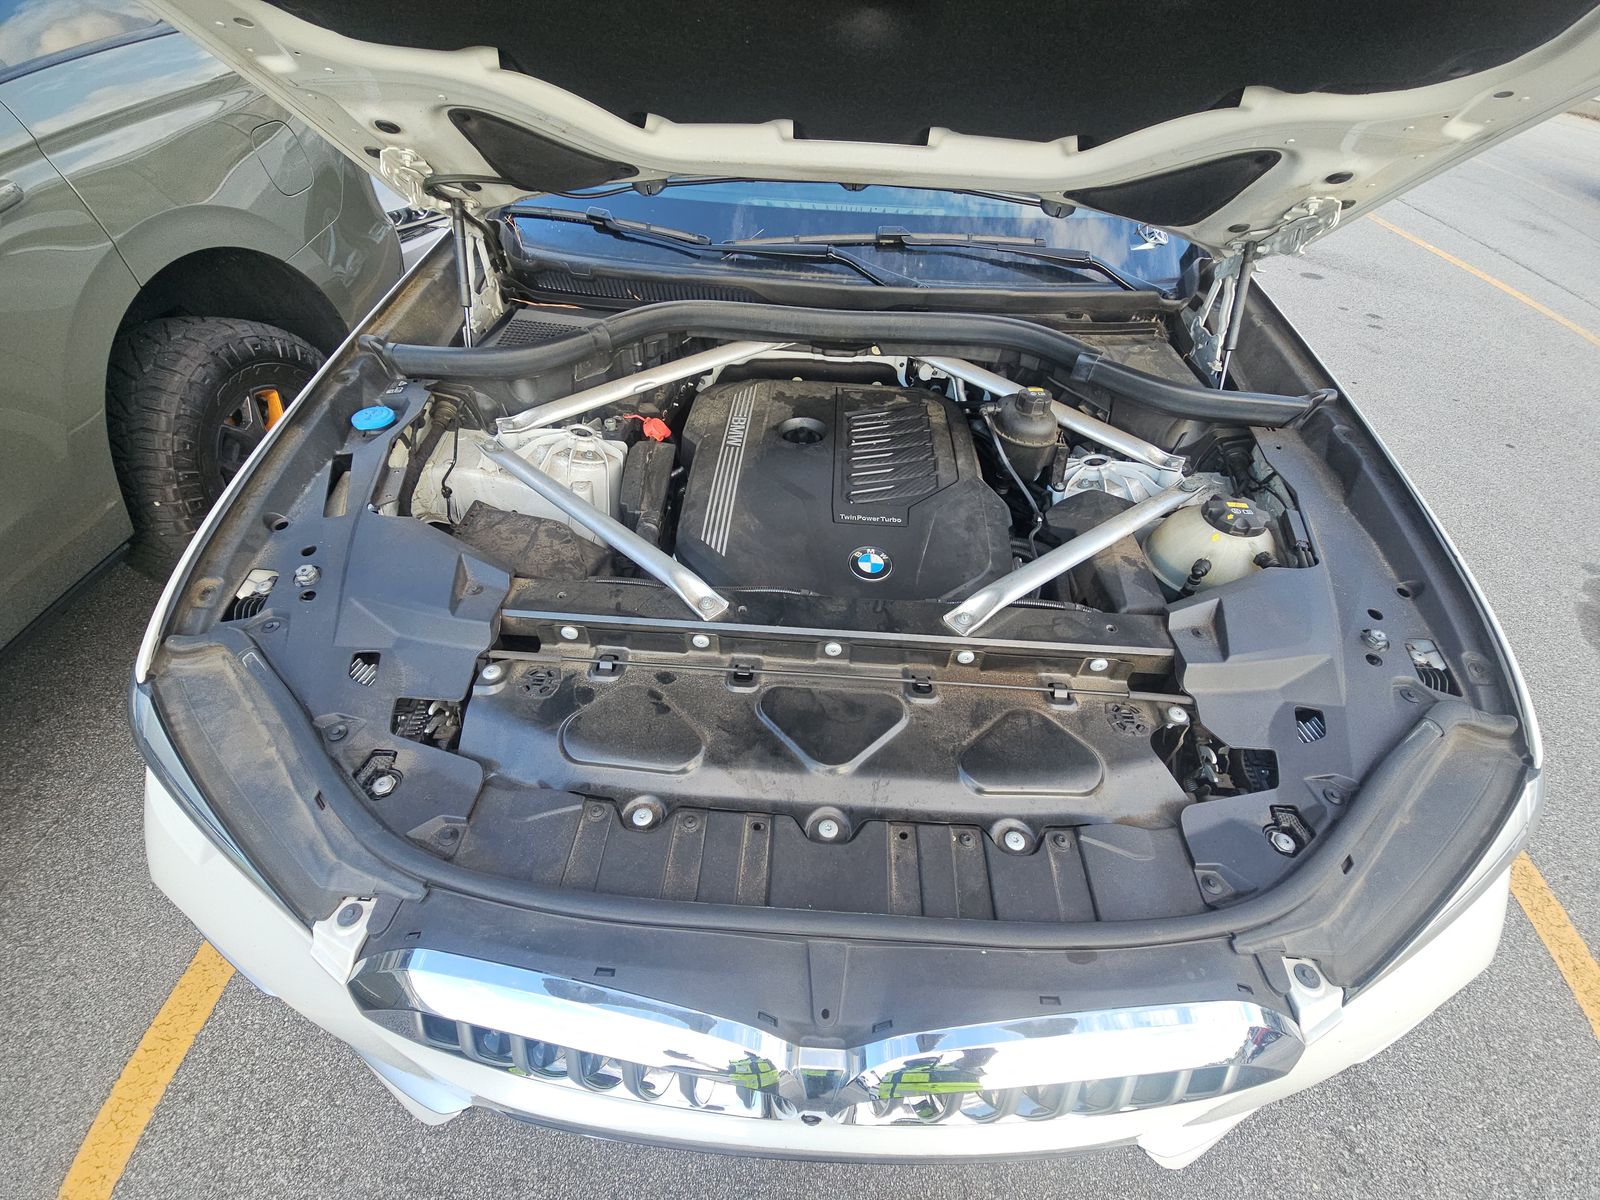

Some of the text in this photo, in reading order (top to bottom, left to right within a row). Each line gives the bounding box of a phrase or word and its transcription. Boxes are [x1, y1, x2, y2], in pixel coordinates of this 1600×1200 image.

[726, 417, 747, 447] BMW
[839, 513, 880, 522] TwinPower
[854, 548, 889, 560] BMW
